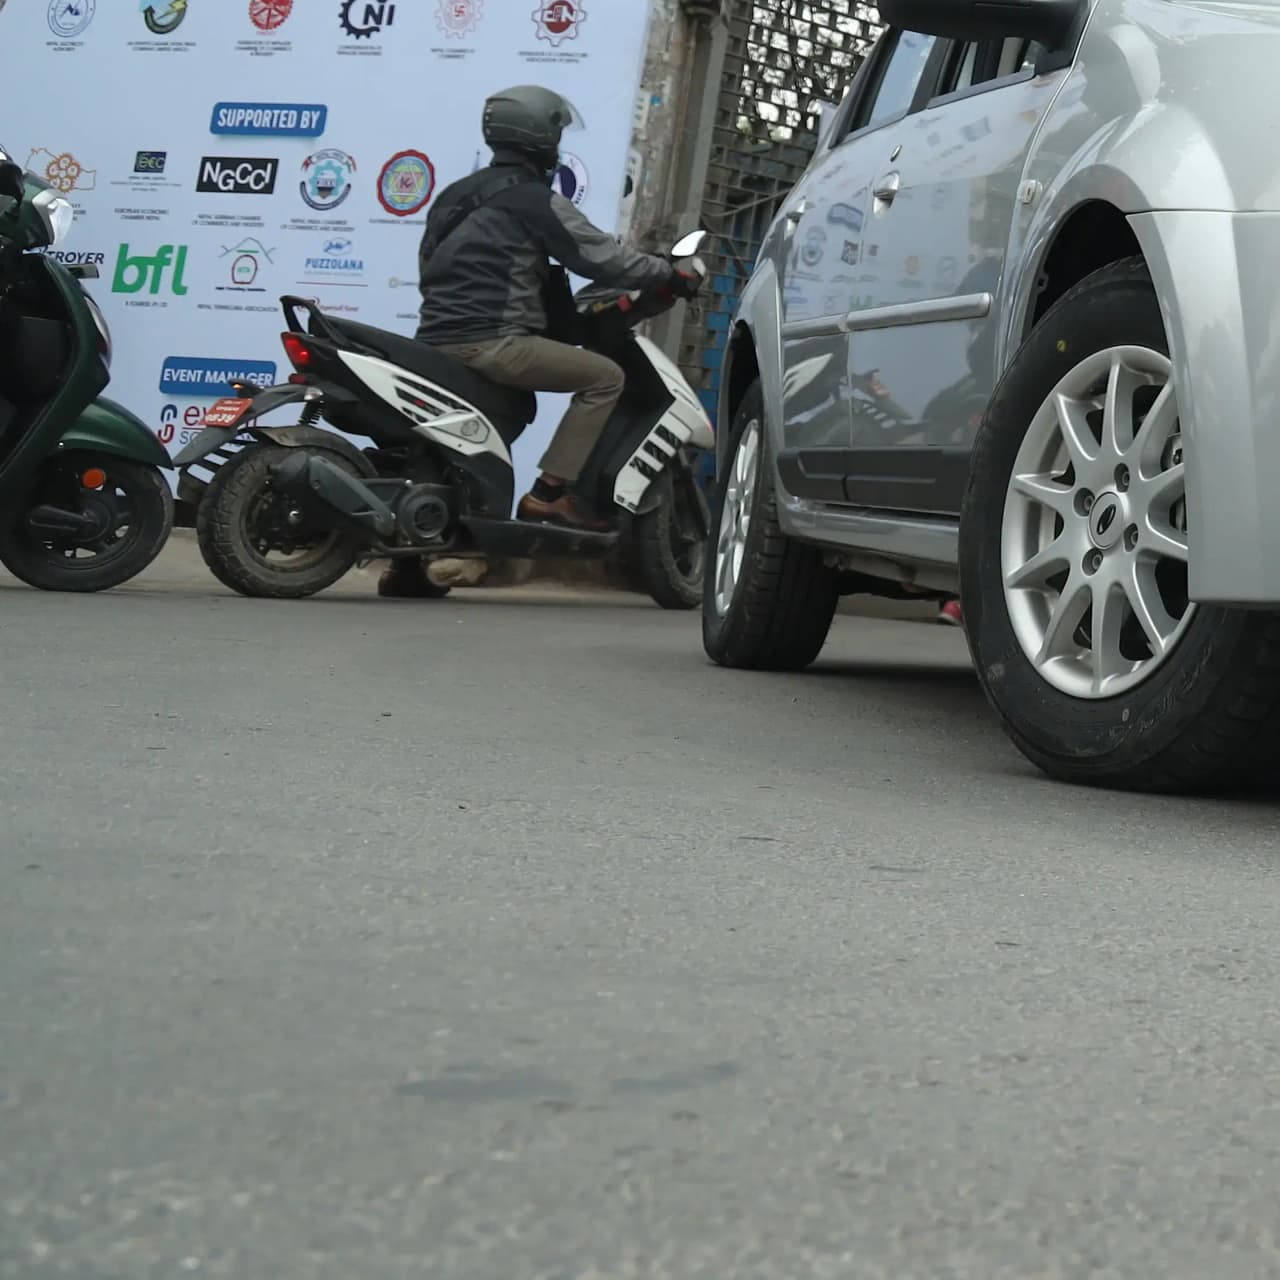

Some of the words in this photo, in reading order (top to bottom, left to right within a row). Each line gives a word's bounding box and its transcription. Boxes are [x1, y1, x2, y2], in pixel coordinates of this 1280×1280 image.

[218, 109, 297, 128] SUPPORTED
[300, 111, 320, 128] BY
[202, 161, 272, 191] NGCCI
[112, 244, 188, 295] bfl
[163, 369, 203, 382] EVENT
